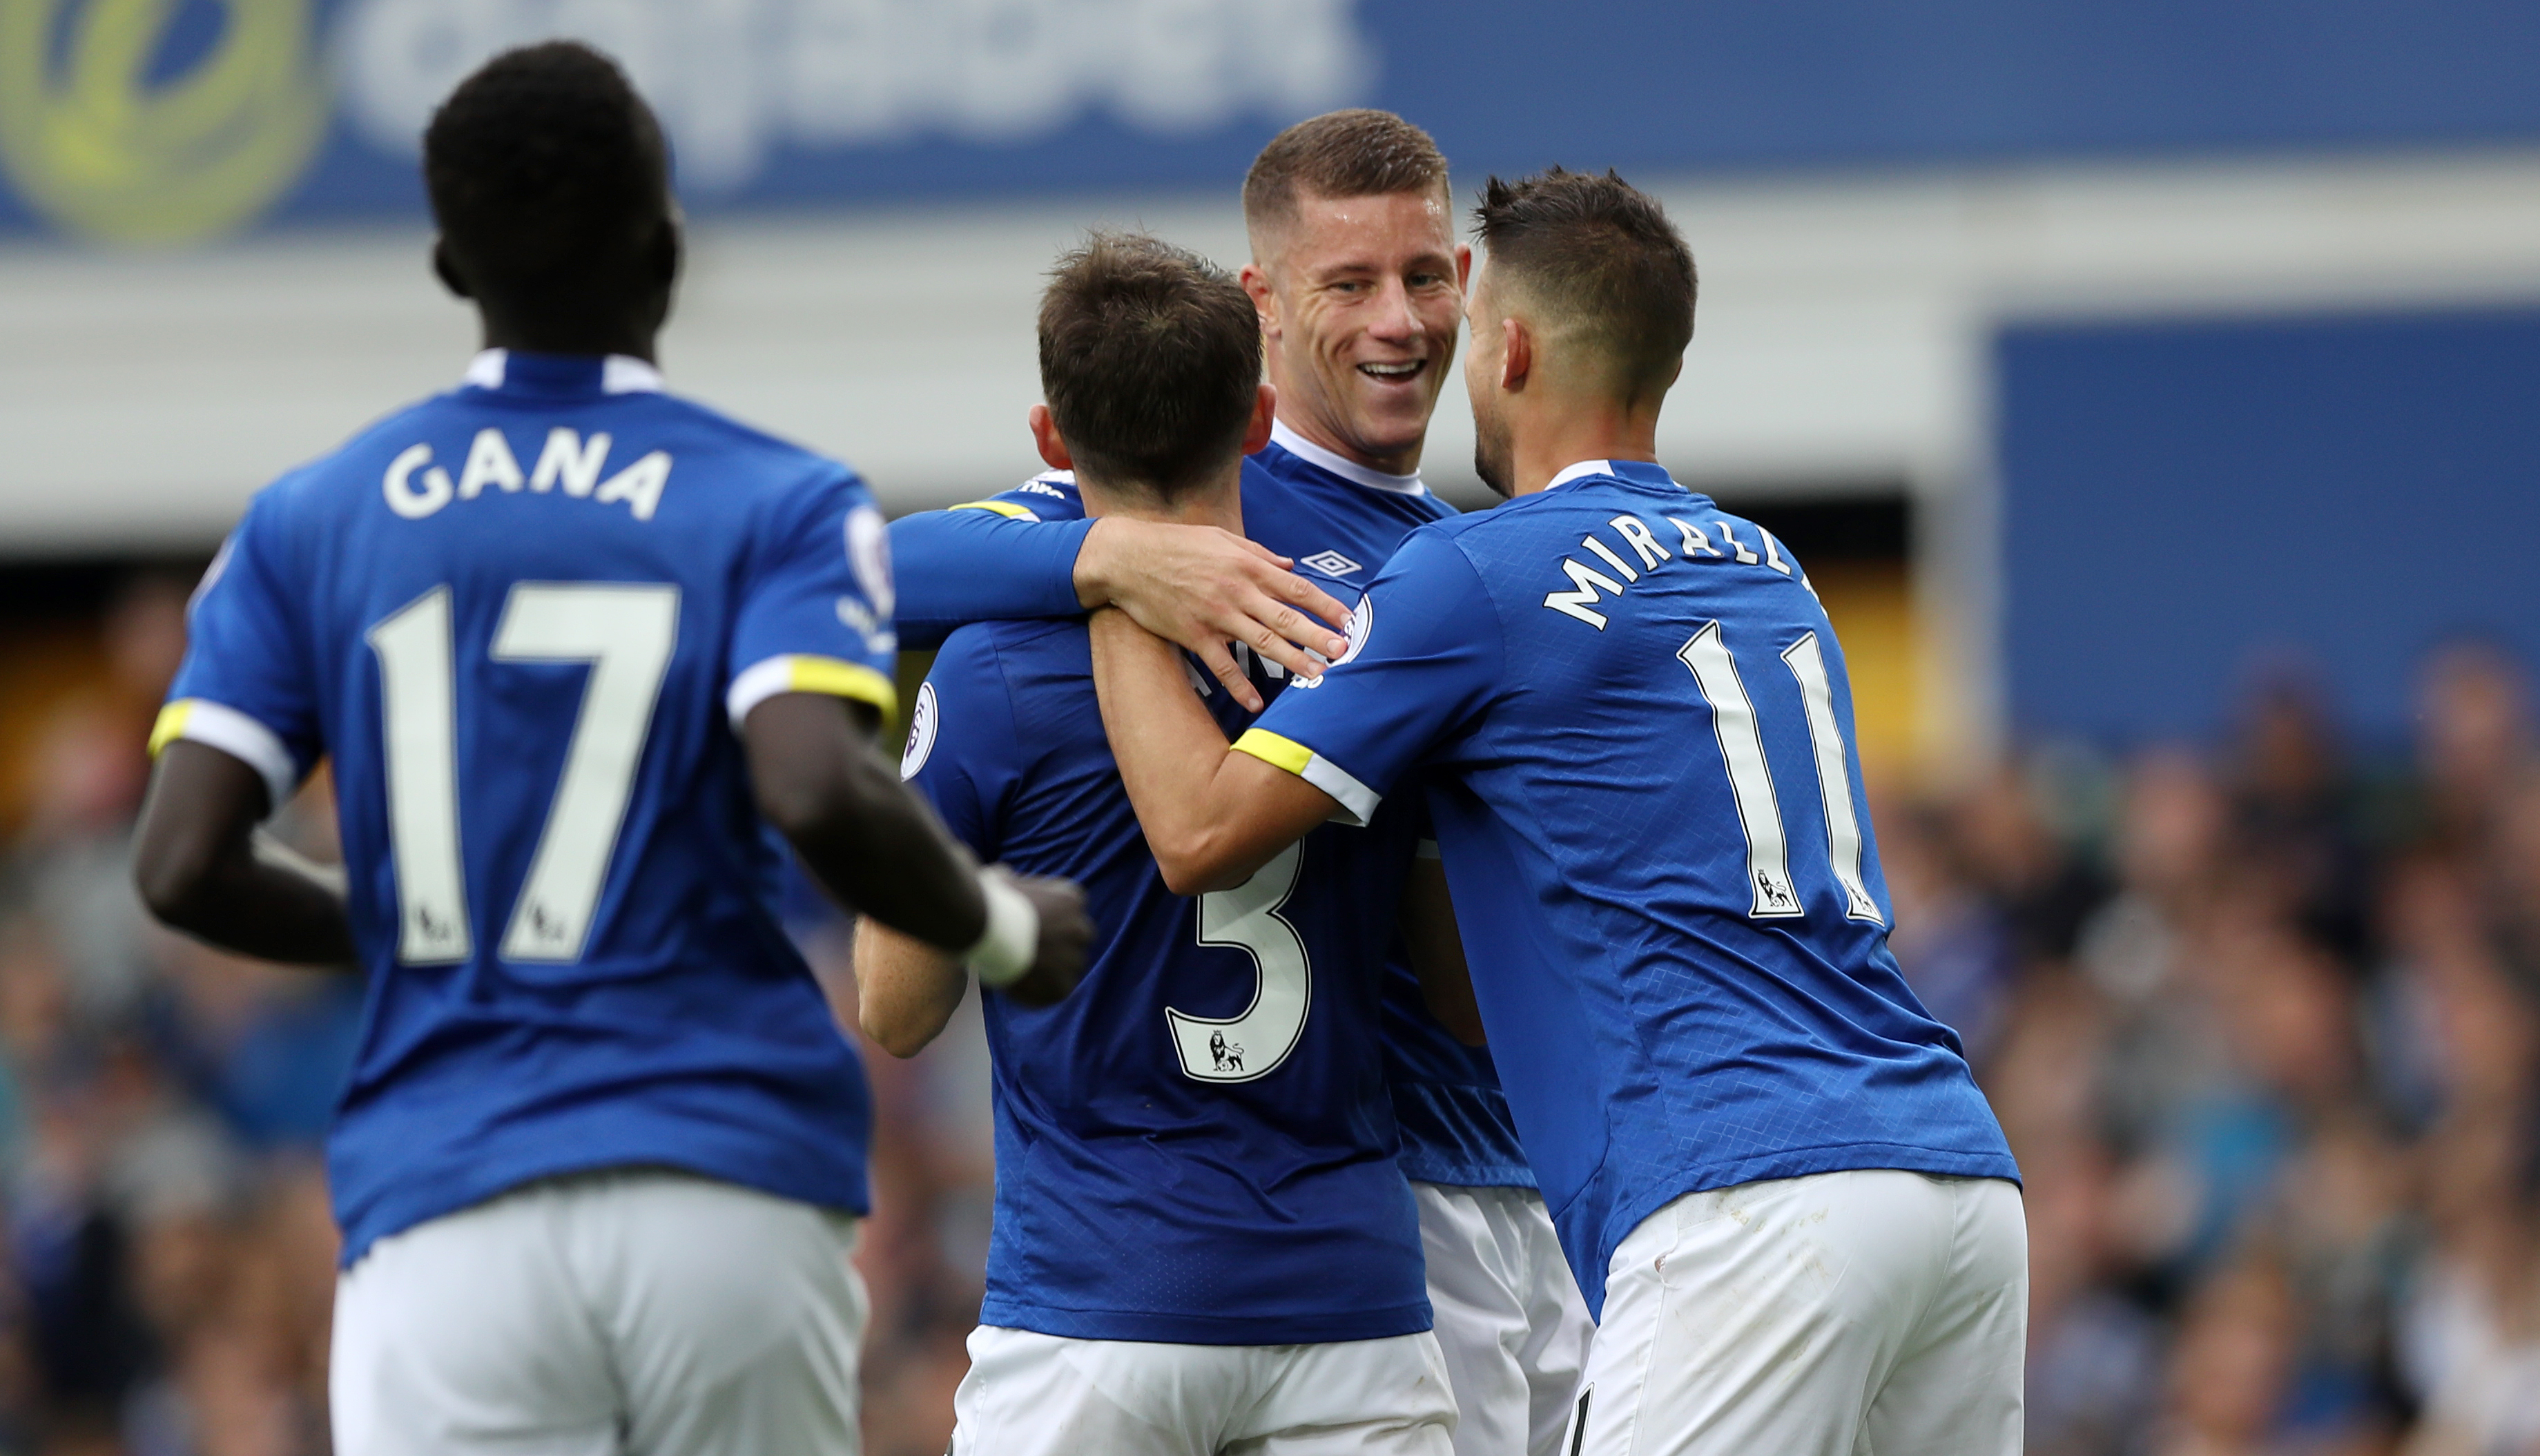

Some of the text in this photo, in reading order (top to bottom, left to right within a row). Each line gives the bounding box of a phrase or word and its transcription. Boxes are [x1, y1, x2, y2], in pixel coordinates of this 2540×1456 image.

[382, 427, 674, 521] GANA
[365, 580, 682, 966] 17
[1676, 619, 1885, 927] 11
[1165, 836, 1312, 1083] 3
